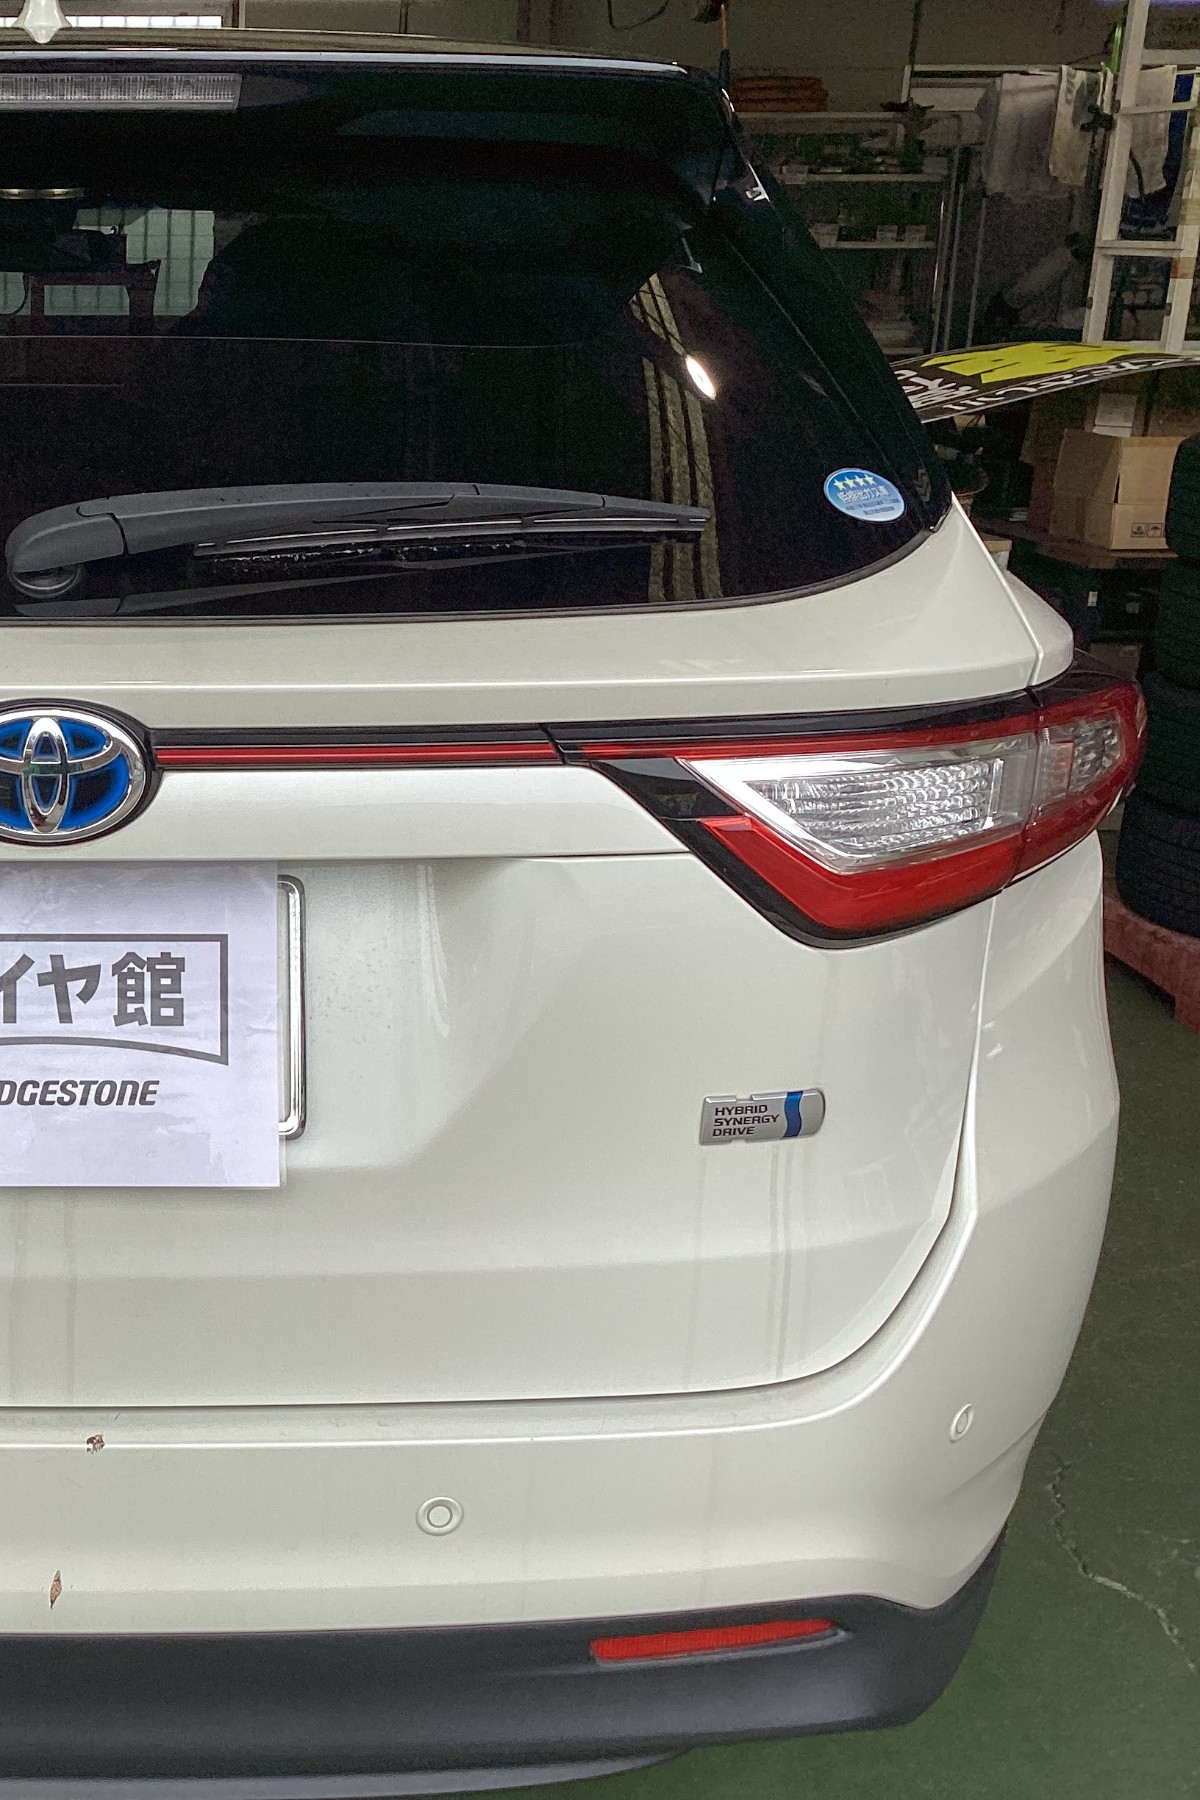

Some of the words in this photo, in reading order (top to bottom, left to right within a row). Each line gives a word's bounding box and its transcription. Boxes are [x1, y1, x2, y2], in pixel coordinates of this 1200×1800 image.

[714, 1104, 768, 1117] HYBRID
[713, 1113, 780, 1127] SYNERGY
[712, 1126, 756, 1137] DRIVE
